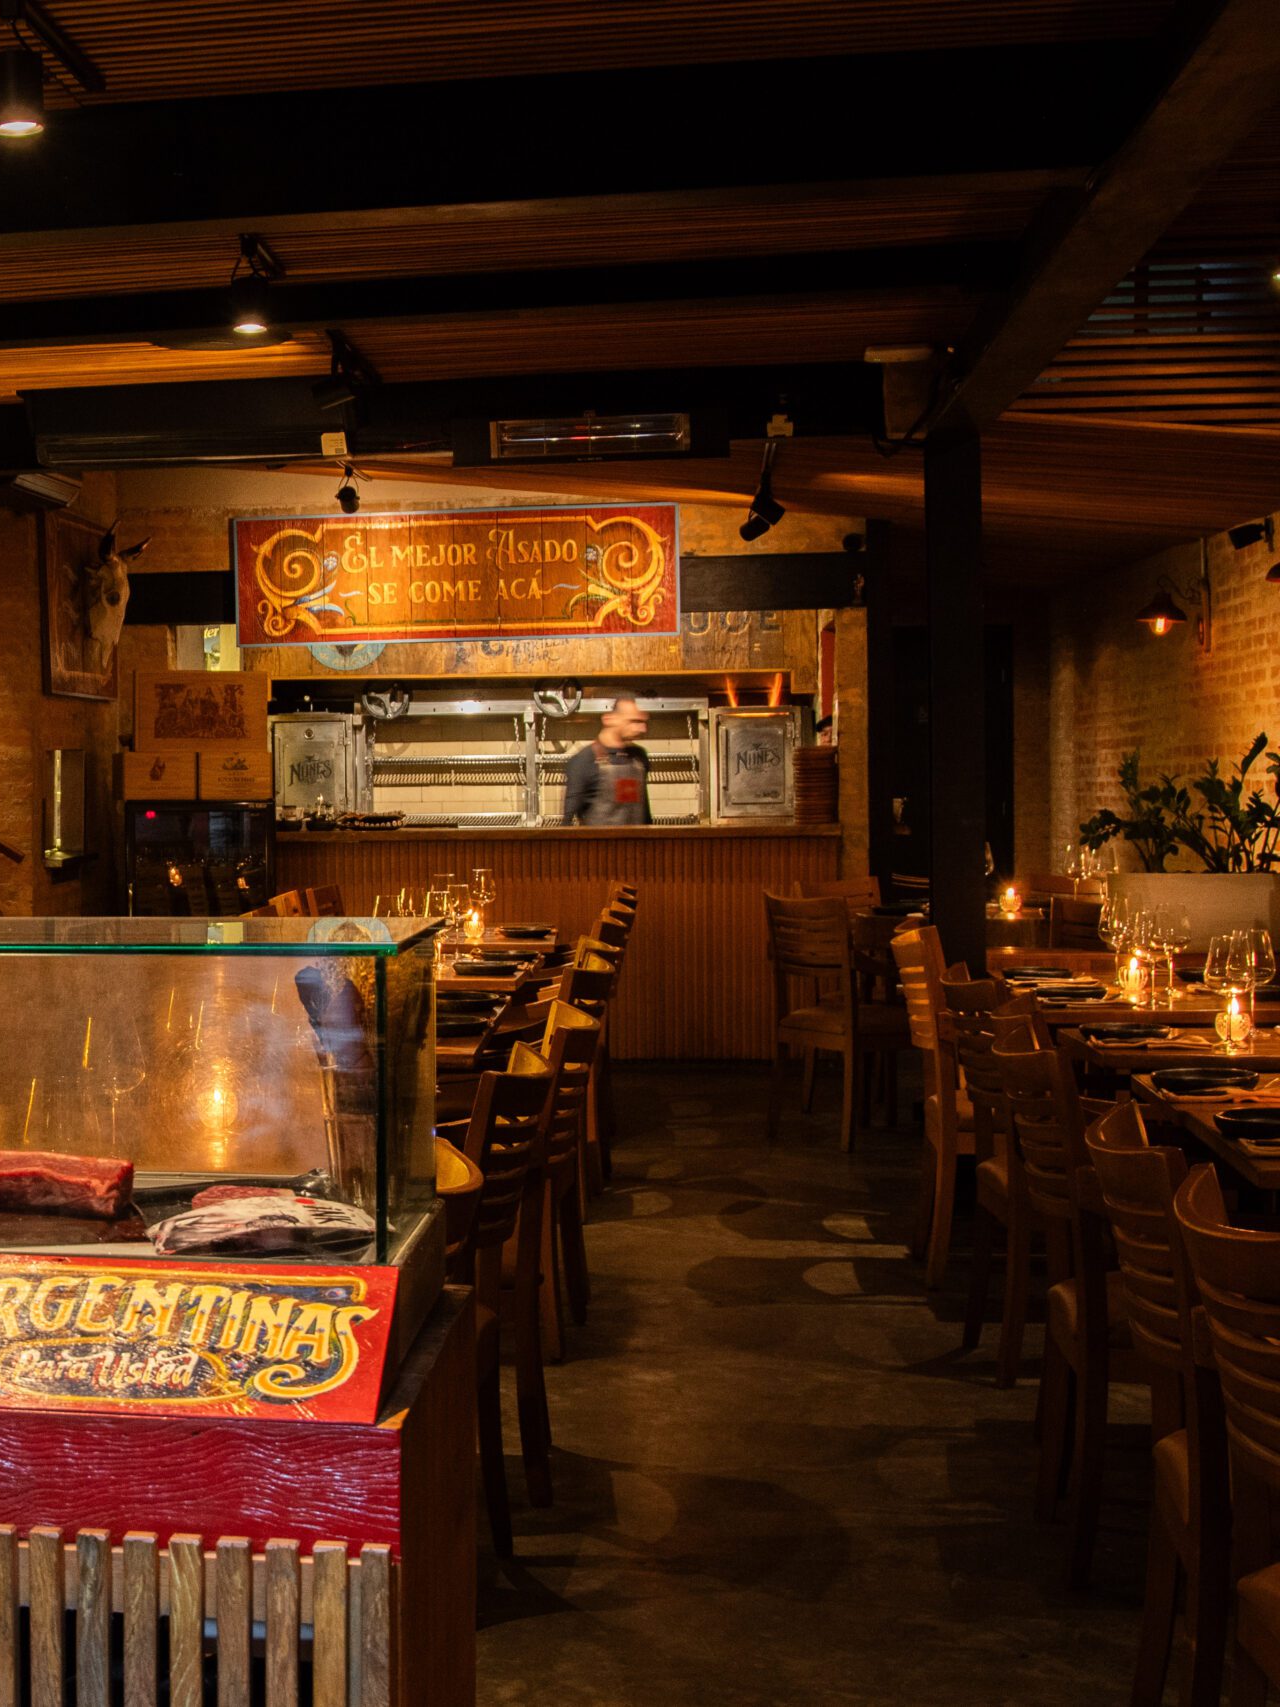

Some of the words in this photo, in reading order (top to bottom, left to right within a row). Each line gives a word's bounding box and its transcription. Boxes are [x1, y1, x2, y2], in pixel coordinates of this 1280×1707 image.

[391, 542, 477, 567] MEJOR
[486, 529, 578, 570] ASADO
[367, 581, 398, 605] SE
[407, 579, 482, 604] COME
[497, 570, 552, 602] ACÁ
[12, 1350, 90, 1381] Para
[62, 1349, 199, 1389] Usted
